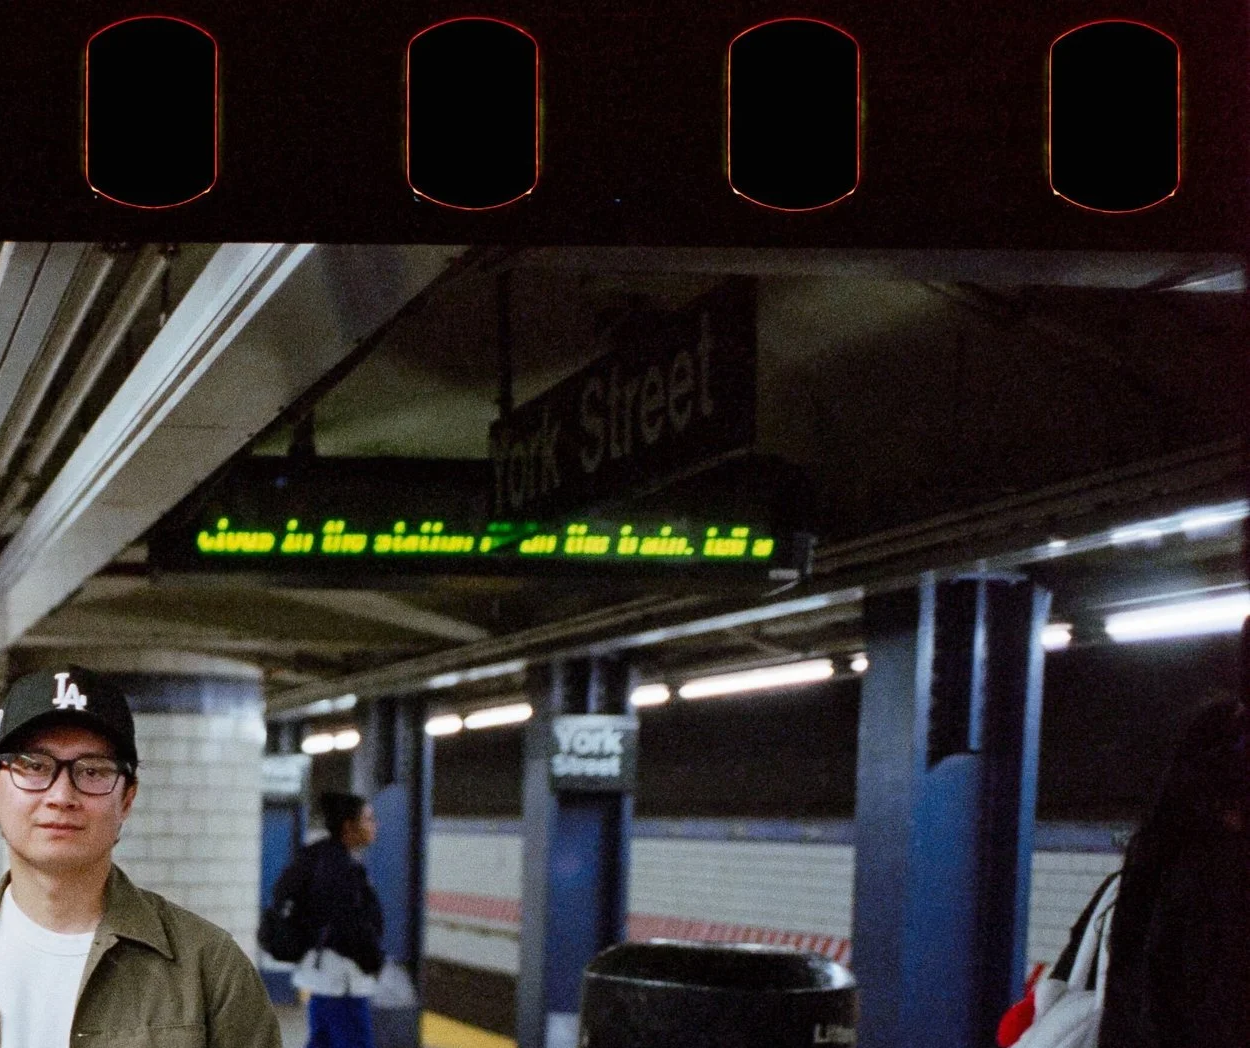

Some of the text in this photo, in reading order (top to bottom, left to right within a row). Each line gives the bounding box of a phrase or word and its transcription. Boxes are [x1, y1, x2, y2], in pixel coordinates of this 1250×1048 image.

[579, 311, 715, 474] Street
[52, 672, 88, 710] LA
[553, 725, 624, 755] York
